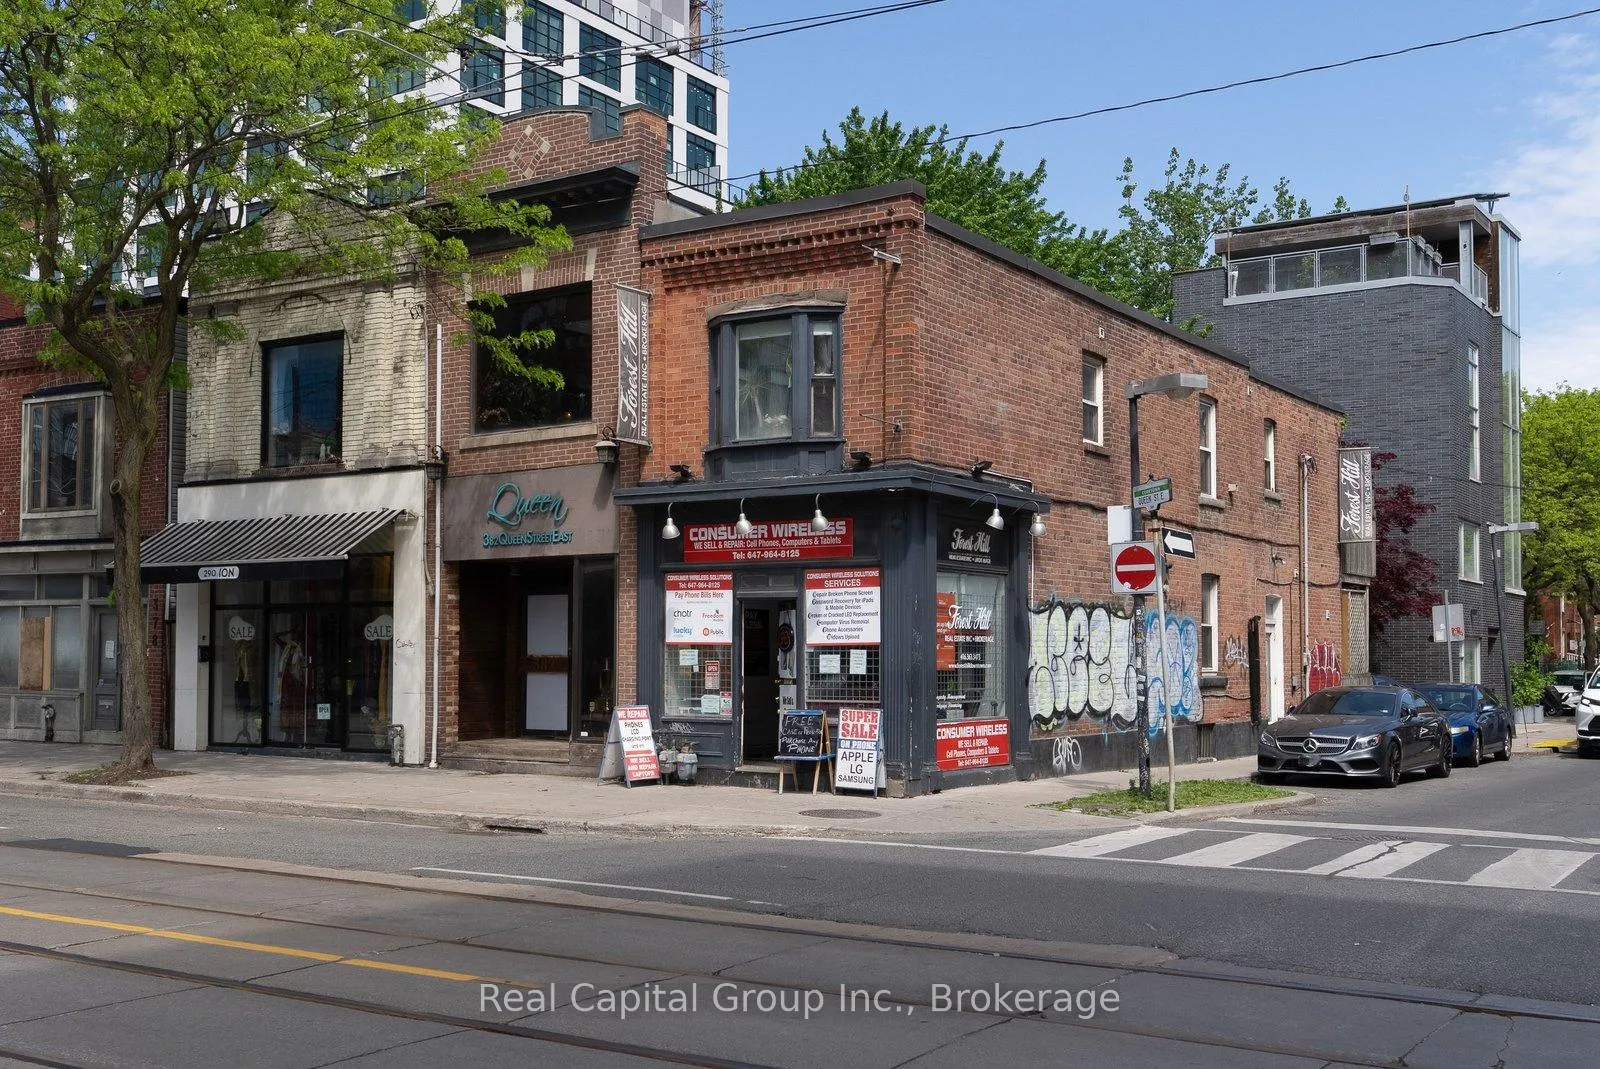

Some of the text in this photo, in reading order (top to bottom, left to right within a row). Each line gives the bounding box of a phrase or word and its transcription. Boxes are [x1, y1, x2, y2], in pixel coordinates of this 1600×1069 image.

[620, 300, 638, 428] Forest Hill
[1138, 496, 1151, 506] QUEEN
[1341, 458, 1361, 534] Forest Hill
[487, 482, 568, 526] Queen
[689, 521, 846, 541] CONSUER WIRELSS
[483, 532, 499, 545] 382
[694, 536, 842, 550] WE SELL & REPAIR: Cell Phones, Computers & Tablets
[732, 550, 800, 560] Tel: 647-964-8125
[824, 579, 861, 588] SERVICES
[674, 592, 684, 600] Pay
[947, 604, 993, 630] Forest Hill
[230, 626, 253, 638] SALE
[366, 626, 392, 638] SALE
[674, 627, 692, 636] lucky
[318, 706, 329, 714] OPEN
[626, 710, 648, 718] REPAIR
[784, 716, 814, 726] FREE
[841, 710, 878, 724] SUPER
[841, 723, 878, 739] SALE
[936, 724, 1008, 740] CONSUMER WIRELESS
[852, 742, 876, 750] PHONE
[958, 740, 964, 748] WE
[964, 740, 972, 748] SELL
[840, 752, 874, 762] APPLE
[946, 750, 954, 758] Cell
[967, 748, 984, 757] Computers
[850, 764, 863, 774] LG
[838, 774, 874, 784] SAMSUNG
